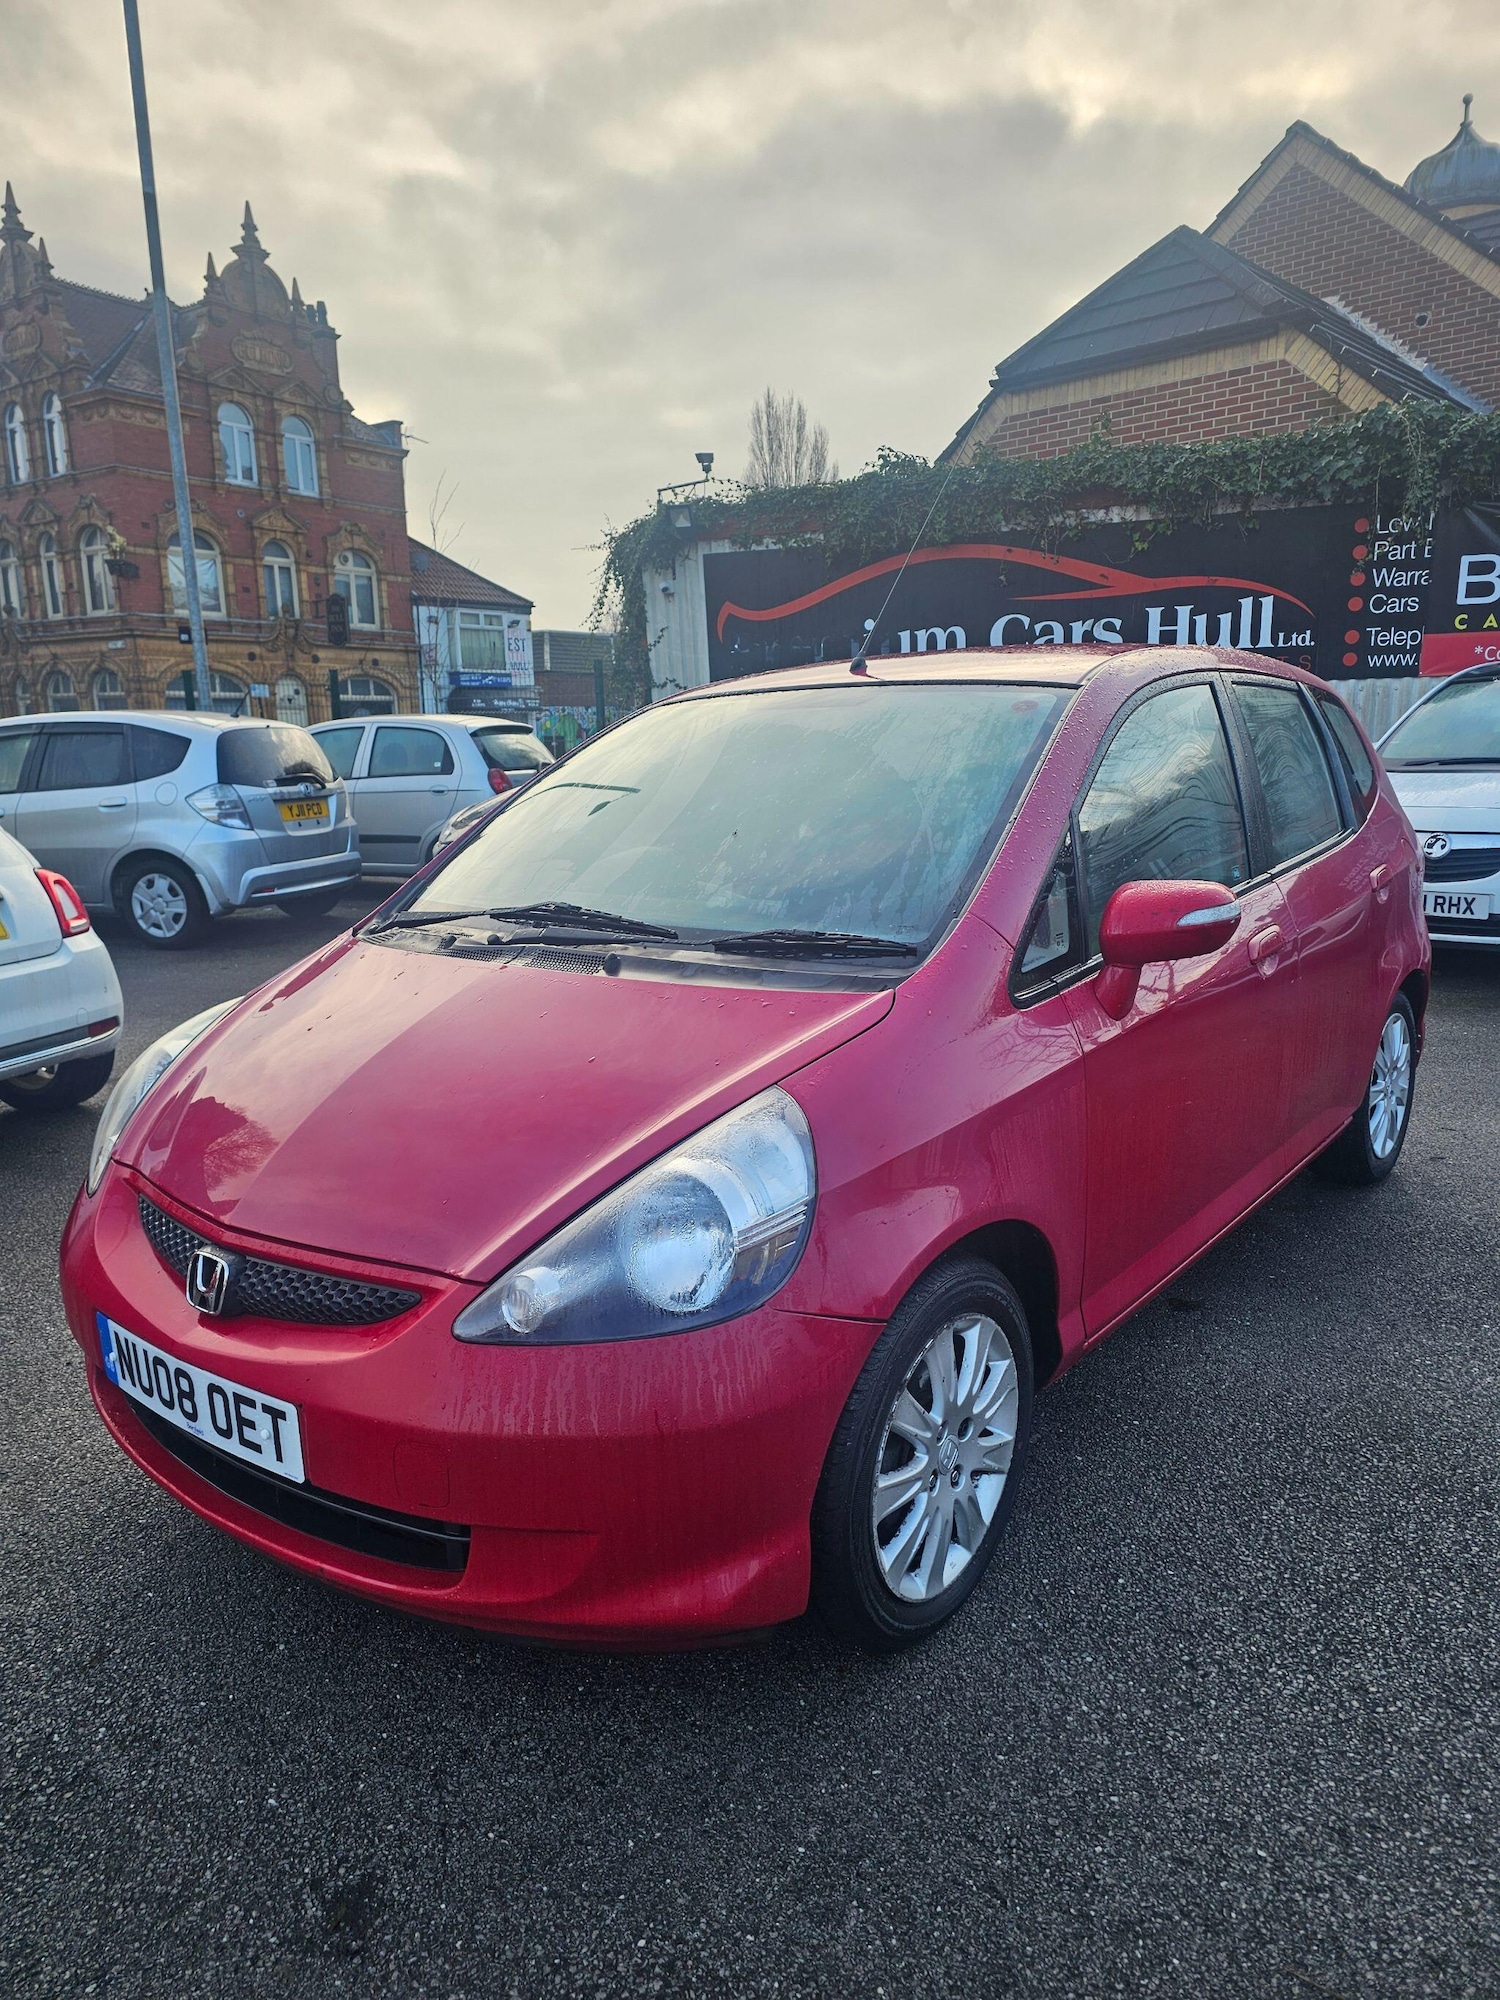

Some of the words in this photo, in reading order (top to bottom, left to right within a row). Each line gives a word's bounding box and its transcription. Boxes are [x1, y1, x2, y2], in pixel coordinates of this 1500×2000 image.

[1374, 540, 1417, 561] Part
[1369, 593, 1419, 613] Cars
[989, 613, 1123, 645] Cars
[1144, 595, 1275, 649] Hull
[1277, 630, 1315, 647] Ltd.
[508, 637, 526, 652] EST
[1366, 627, 1421, 649] Telep
[1368, 654, 1419, 667] www.
[1433, 895, 1476, 915] RHX
[113, 1330, 199, 1423] NU08
[207, 1382, 287, 1464] OET
